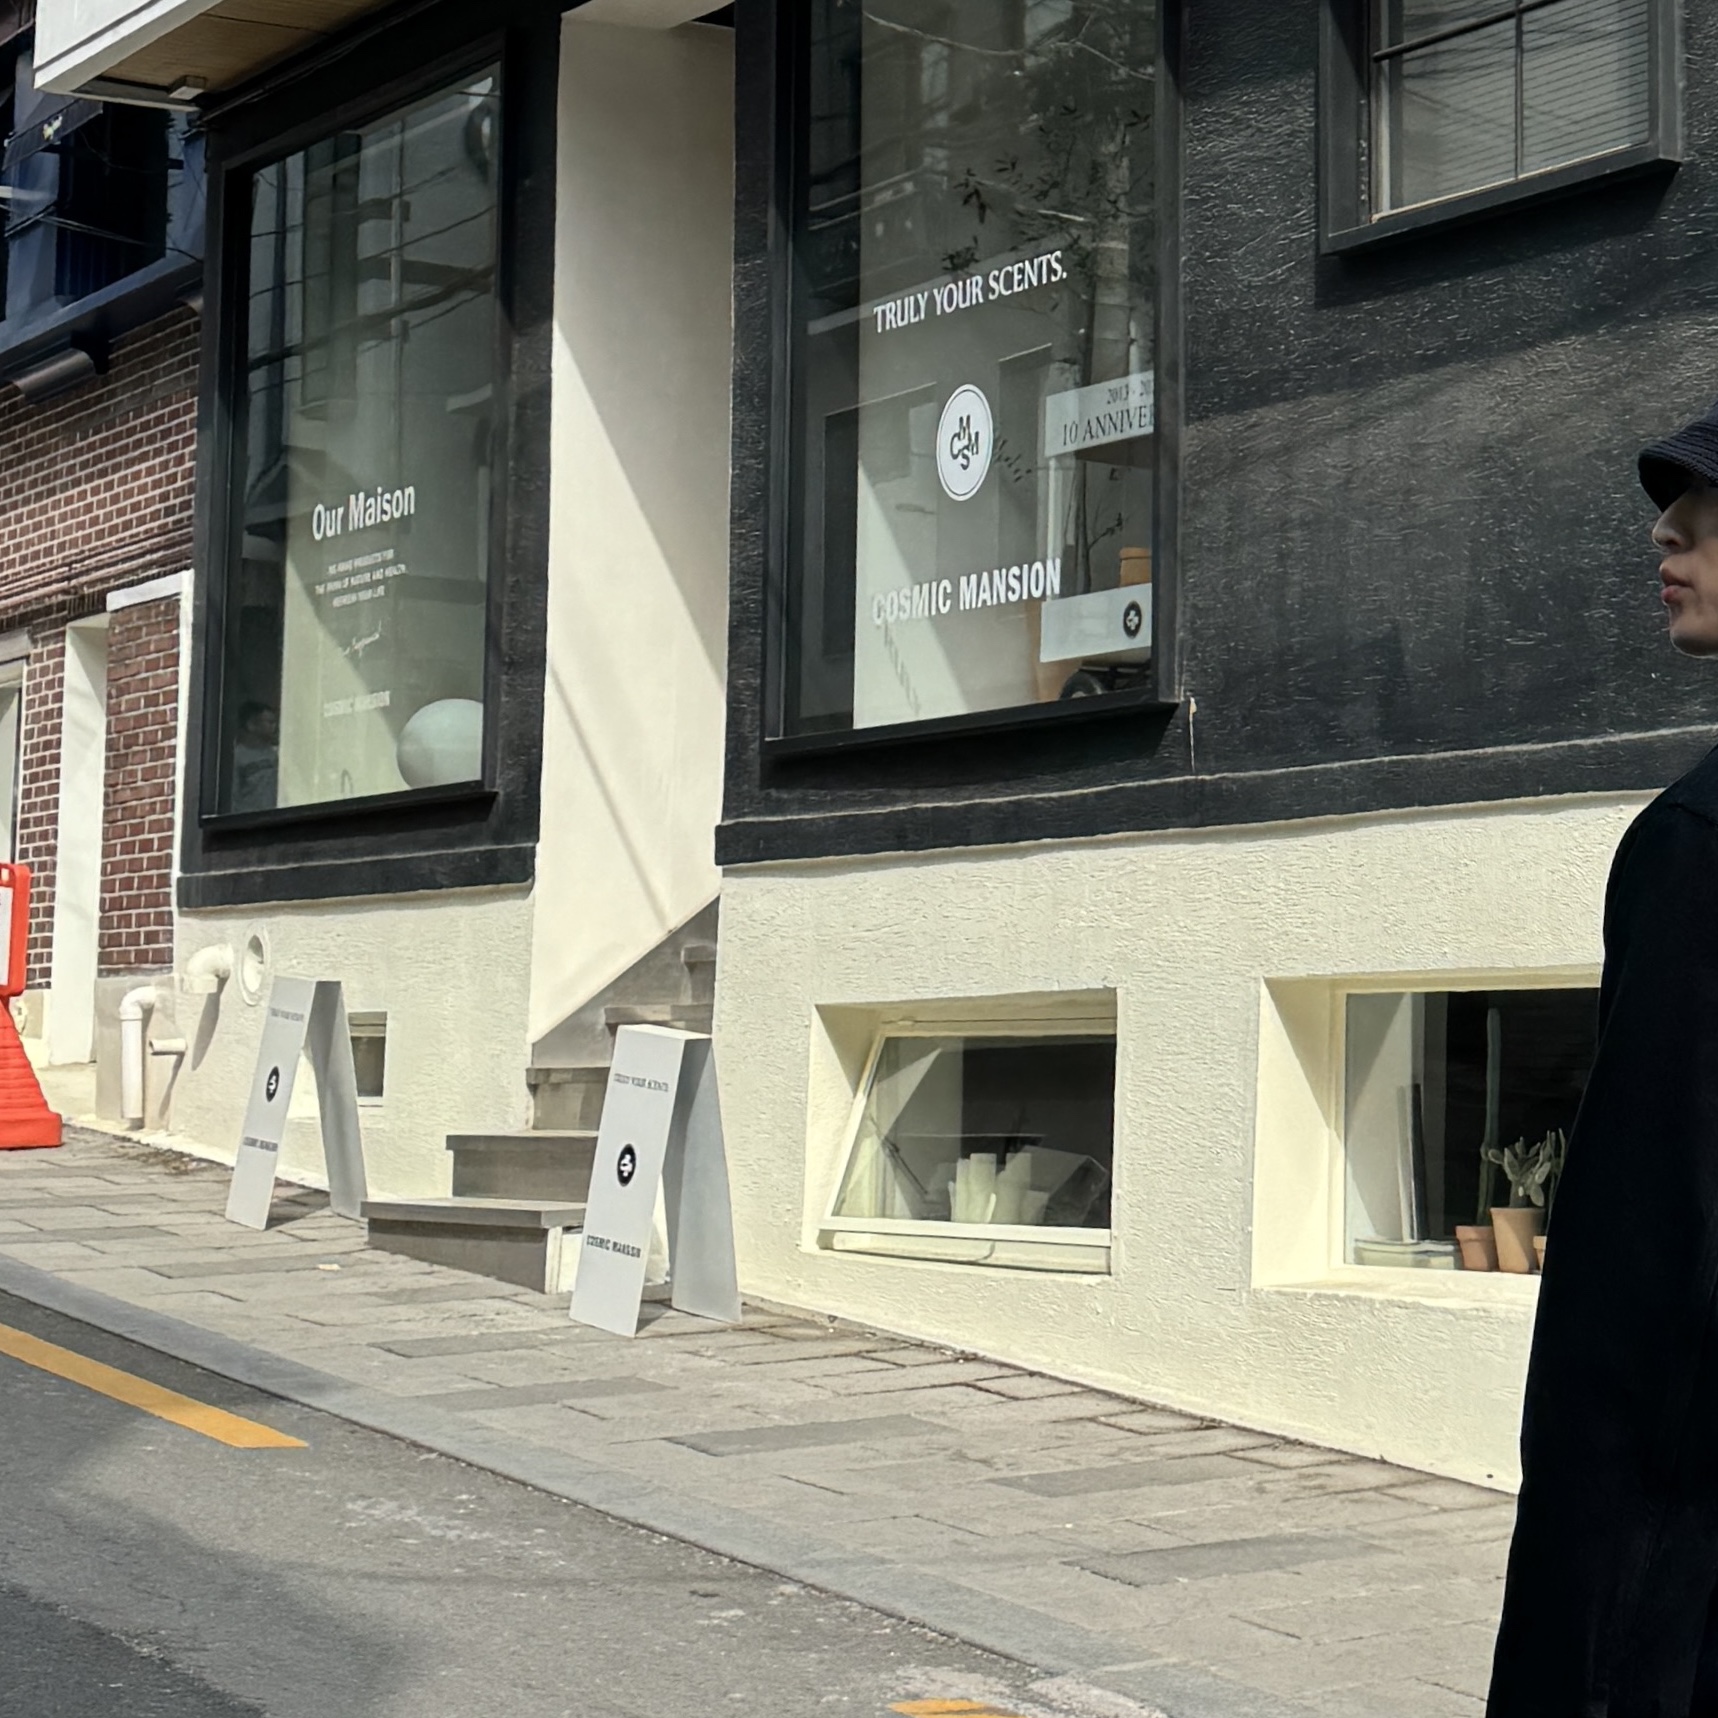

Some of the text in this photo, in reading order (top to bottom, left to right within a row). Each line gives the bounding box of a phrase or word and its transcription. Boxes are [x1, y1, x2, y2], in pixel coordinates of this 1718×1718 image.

[873, 250, 1067, 333] TRULY YOUR SCENTS.
[1062, 420, 1079, 447] 10
[312, 485, 415, 541] Our Maison
[872, 557, 1062, 625] COSMIC MANSION
